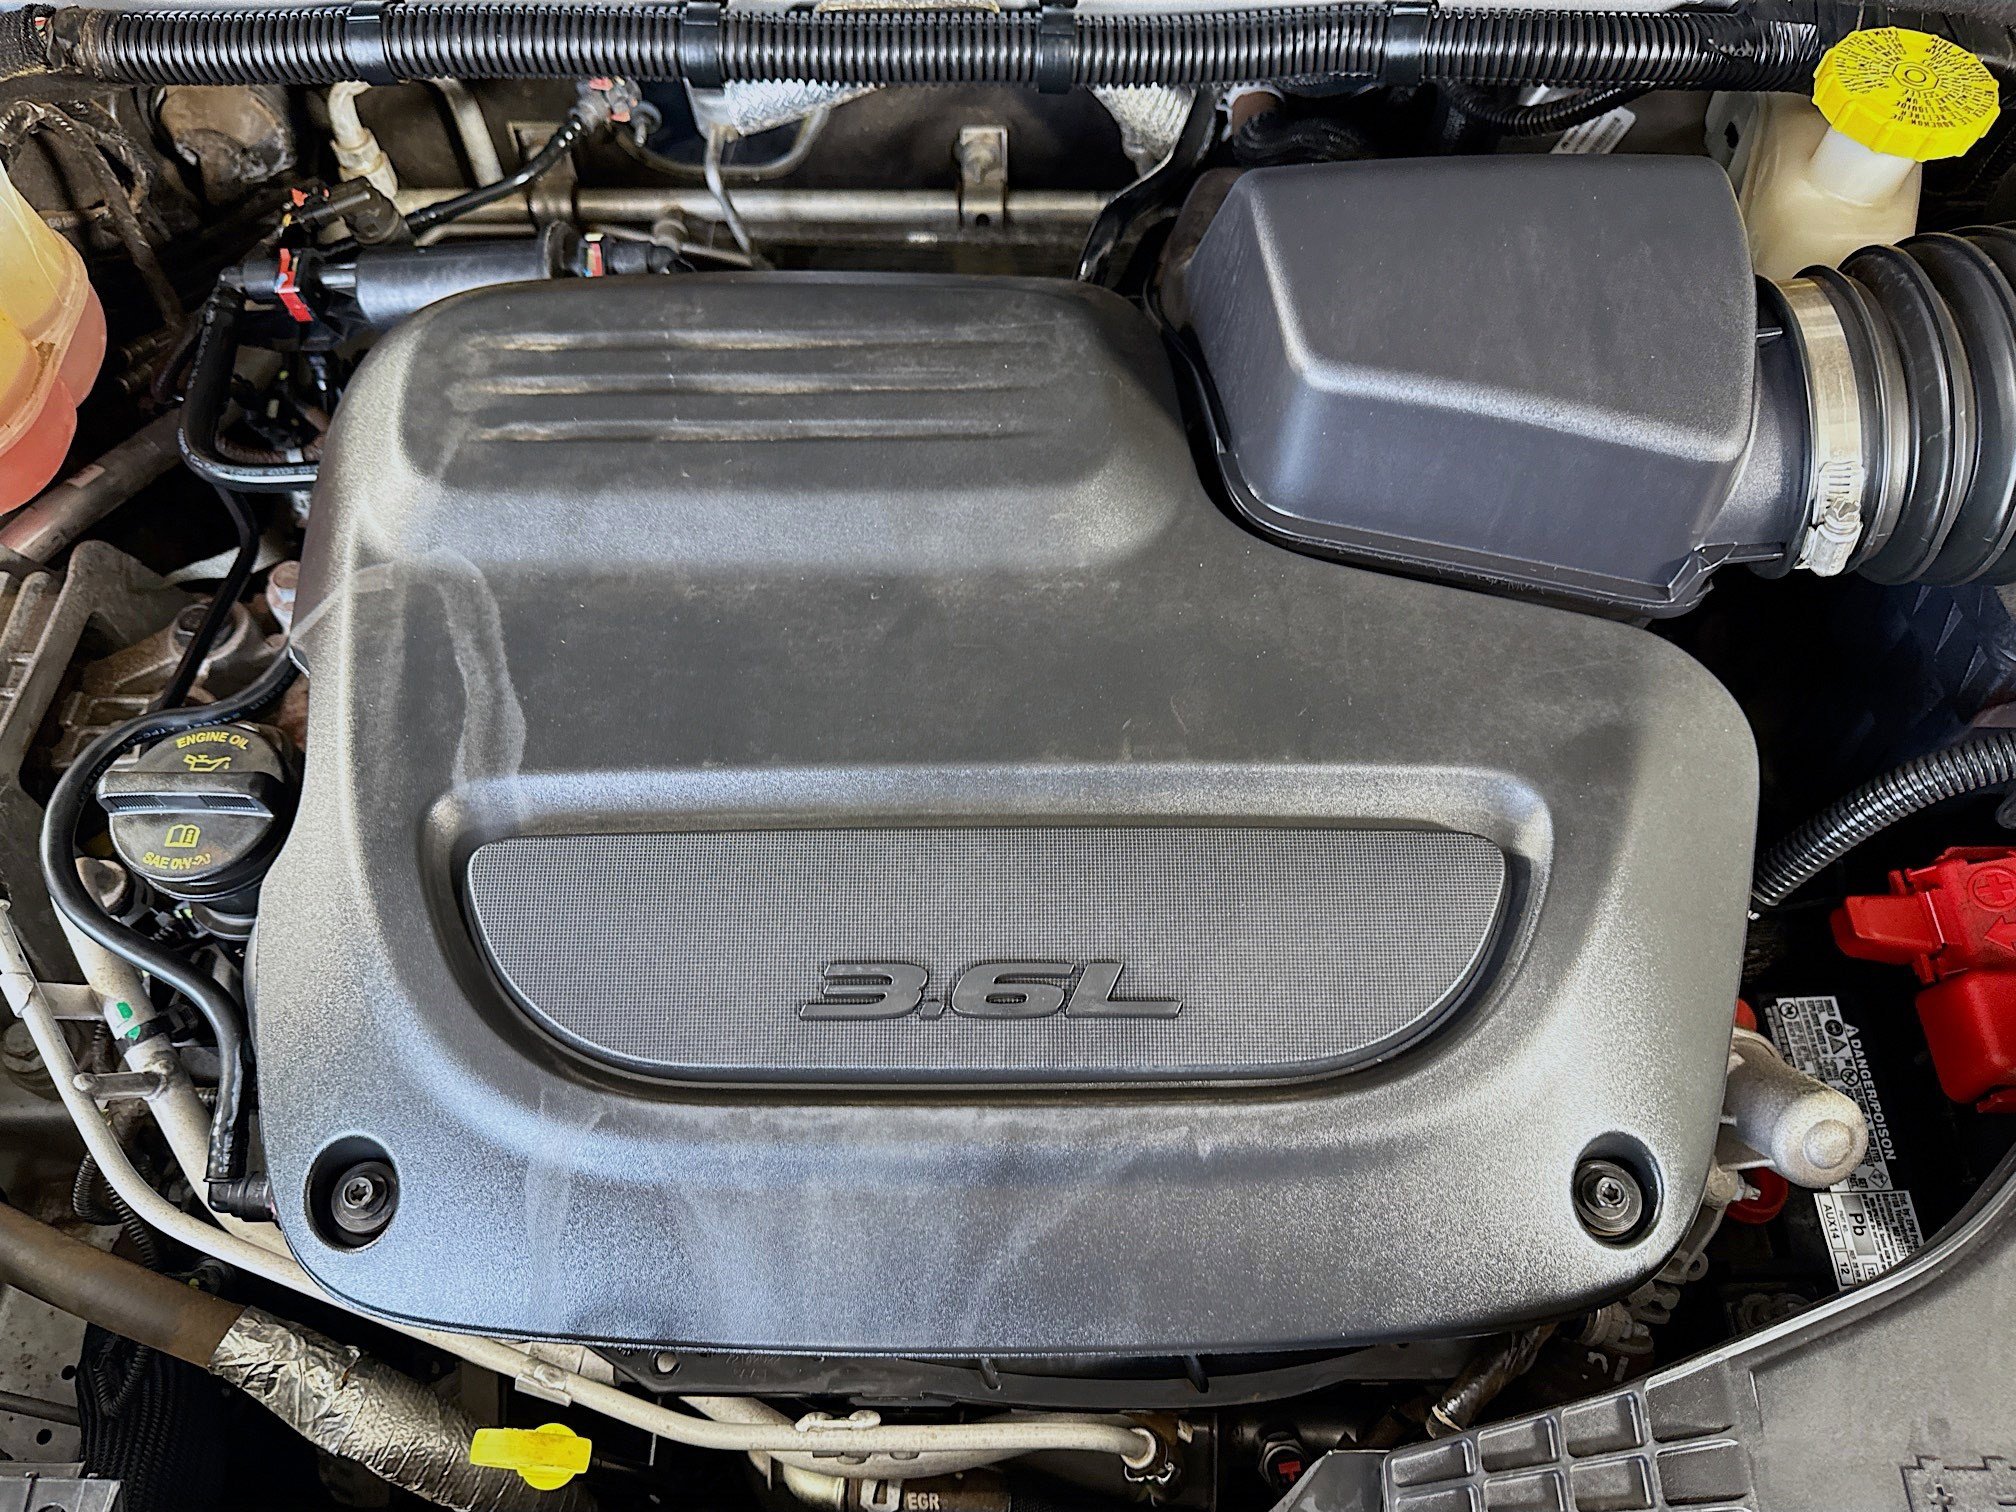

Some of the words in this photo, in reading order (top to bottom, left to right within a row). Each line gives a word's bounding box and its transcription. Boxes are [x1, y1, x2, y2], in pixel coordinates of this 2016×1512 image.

[176, 732, 229, 749] ENGINE
[229, 735, 250, 750] OIL
[143, 852, 168, 869] SAE
[800, 963, 1183, 1019] 3.6L
[1850, 1039, 1896, 1160] DANGER/POISON
[1849, 1213, 1866, 1236] Pb
[1823, 1204, 1840, 1238] AUX14
[1840, 1262, 1850, 1275] 12
[907, 1492, 941, 1511] EGR
